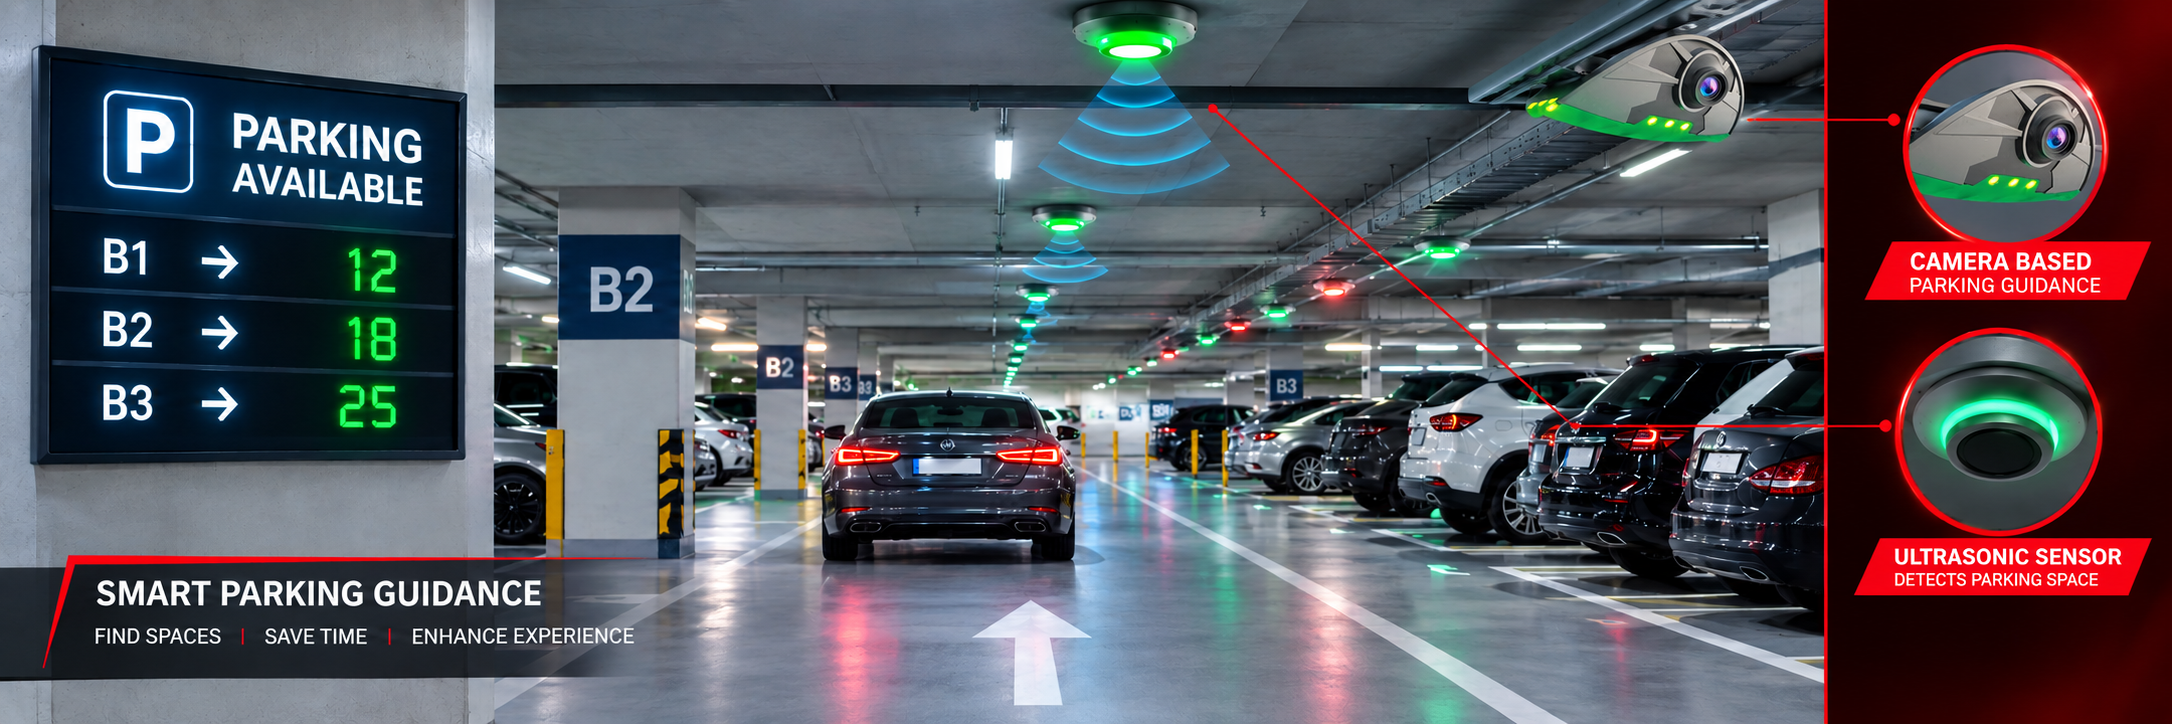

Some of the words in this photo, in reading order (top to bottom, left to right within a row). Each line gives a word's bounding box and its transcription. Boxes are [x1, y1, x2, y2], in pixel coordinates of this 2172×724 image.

[126, 108, 175, 174] P
[232, 112, 423, 164] PARKING
[232, 163, 423, 207] AVAILABLE
[102, 237, 147, 276] B1
[347, 246, 398, 294] 12
[590, 266, 654, 313] B2
[102, 310, 153, 348] B2
[347, 315, 398, 362] 18
[765, 356, 795, 378] B2
[828, 374, 852, 393] B3
[1276, 377, 1297, 394] B3
[102, 384, 153, 421] B3
[338, 384, 397, 429] 25
